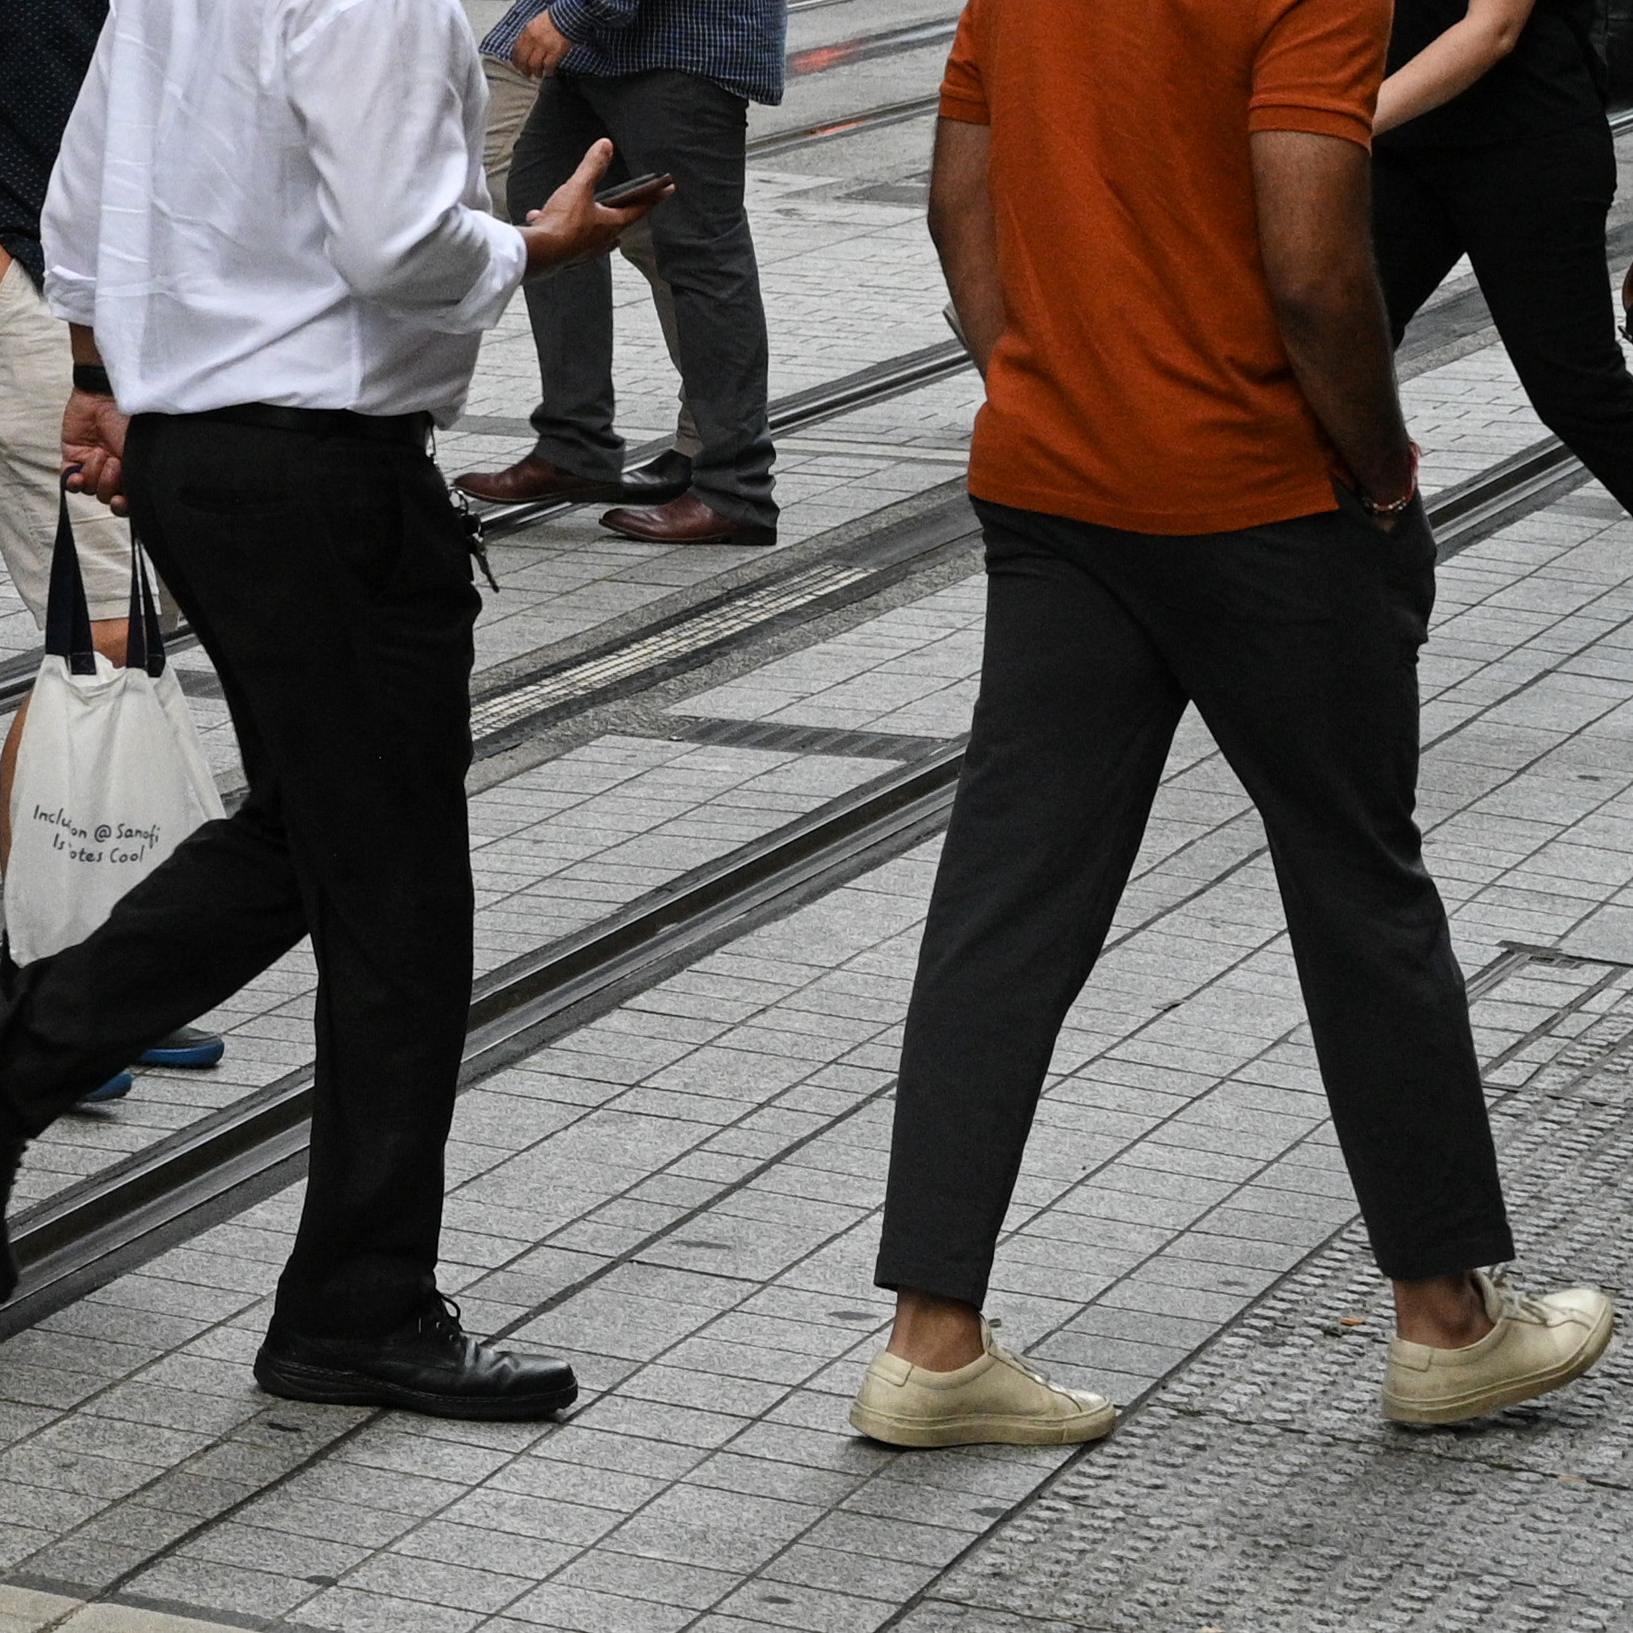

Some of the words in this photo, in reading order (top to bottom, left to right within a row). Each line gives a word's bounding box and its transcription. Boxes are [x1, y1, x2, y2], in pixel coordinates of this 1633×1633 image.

[53, 833, 65, 850] Is
[69, 842, 103, 863] otes
[110, 845, 145, 863] Cool
[94, 825, 112, 842] @
[116, 823, 161, 849] Sanofi
